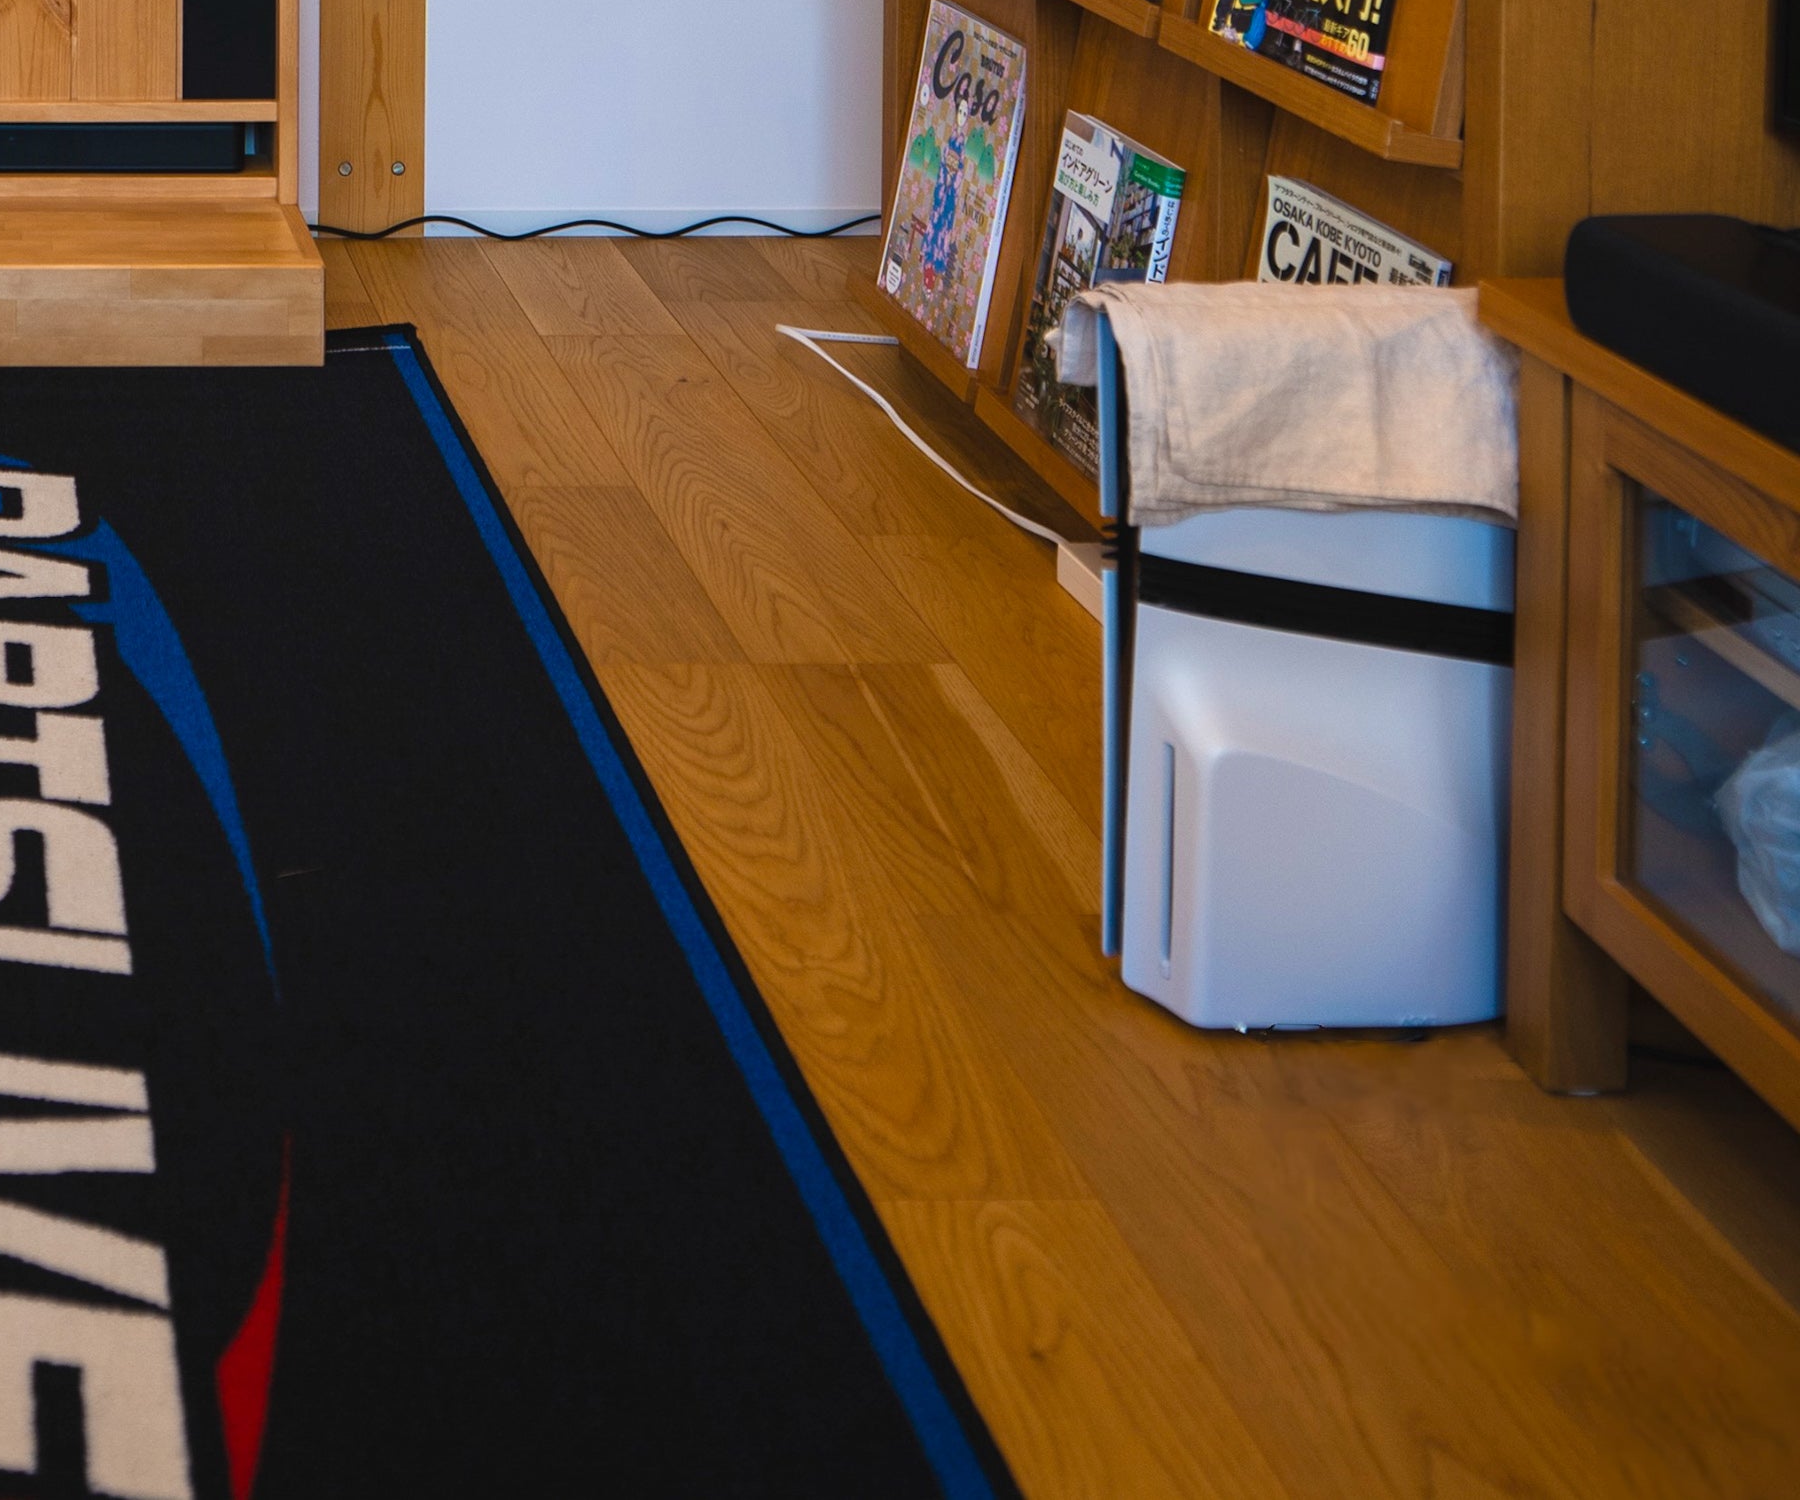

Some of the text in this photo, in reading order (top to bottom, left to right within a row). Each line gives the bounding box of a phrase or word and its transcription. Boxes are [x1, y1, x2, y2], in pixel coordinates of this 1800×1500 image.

[1347, 30, 1370, 62] 60
[933, 30, 1000, 126] Casa
[1062, 153, 1113, 194] インドアグリーン
[1273, 197, 1313, 231] OSAKA
[1316, 220, 1342, 247] KOBE
[1345, 234, 1382, 268] KYOTO
